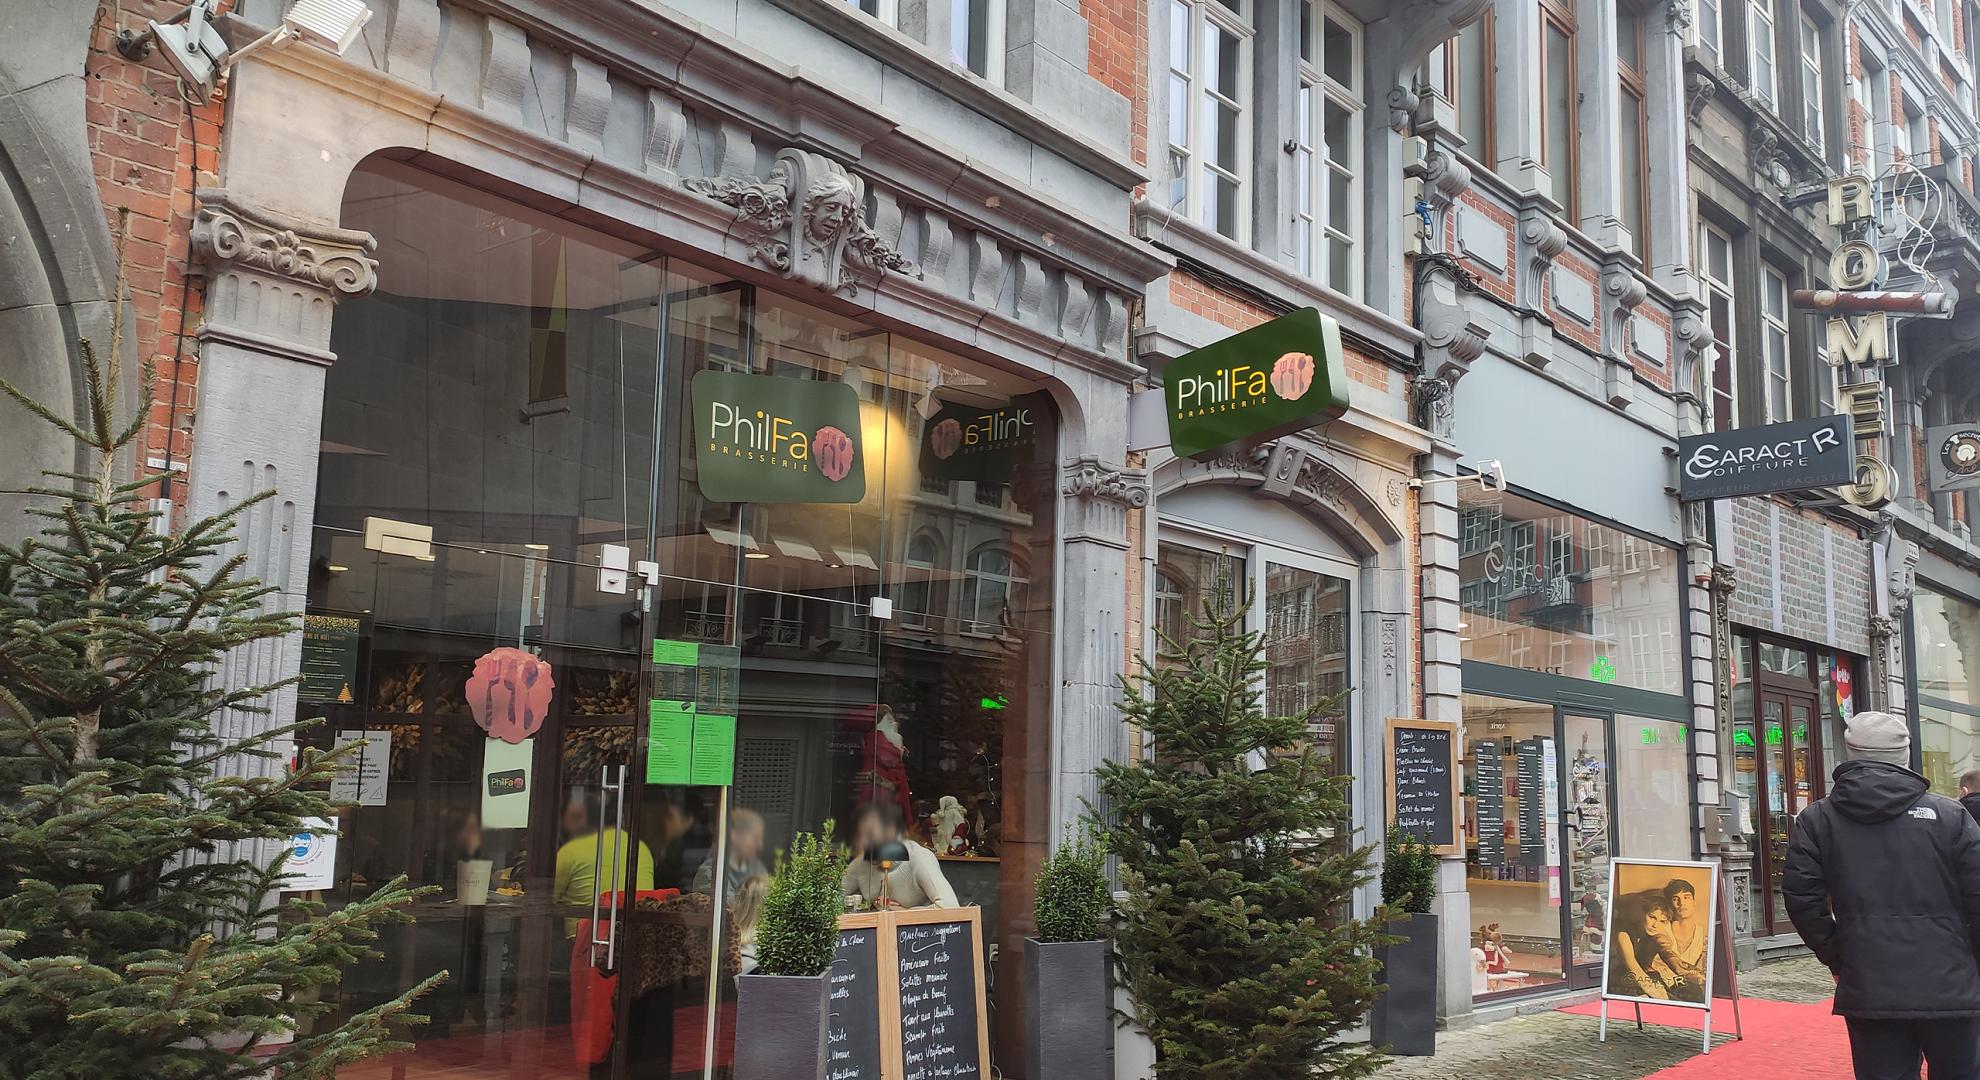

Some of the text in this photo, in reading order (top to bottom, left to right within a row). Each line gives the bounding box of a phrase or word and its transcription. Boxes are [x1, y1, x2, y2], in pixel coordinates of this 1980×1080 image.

[1825, 174, 1890, 505] ROMEO
[1178, 366, 1267, 410] PhilFa
[1178, 396, 1267, 420] BRASSERIE
[711, 401, 808, 461] PhilFa
[709, 443, 808, 472] BRASSERIE
[1685, 456, 1809, 481] COIFFURE
